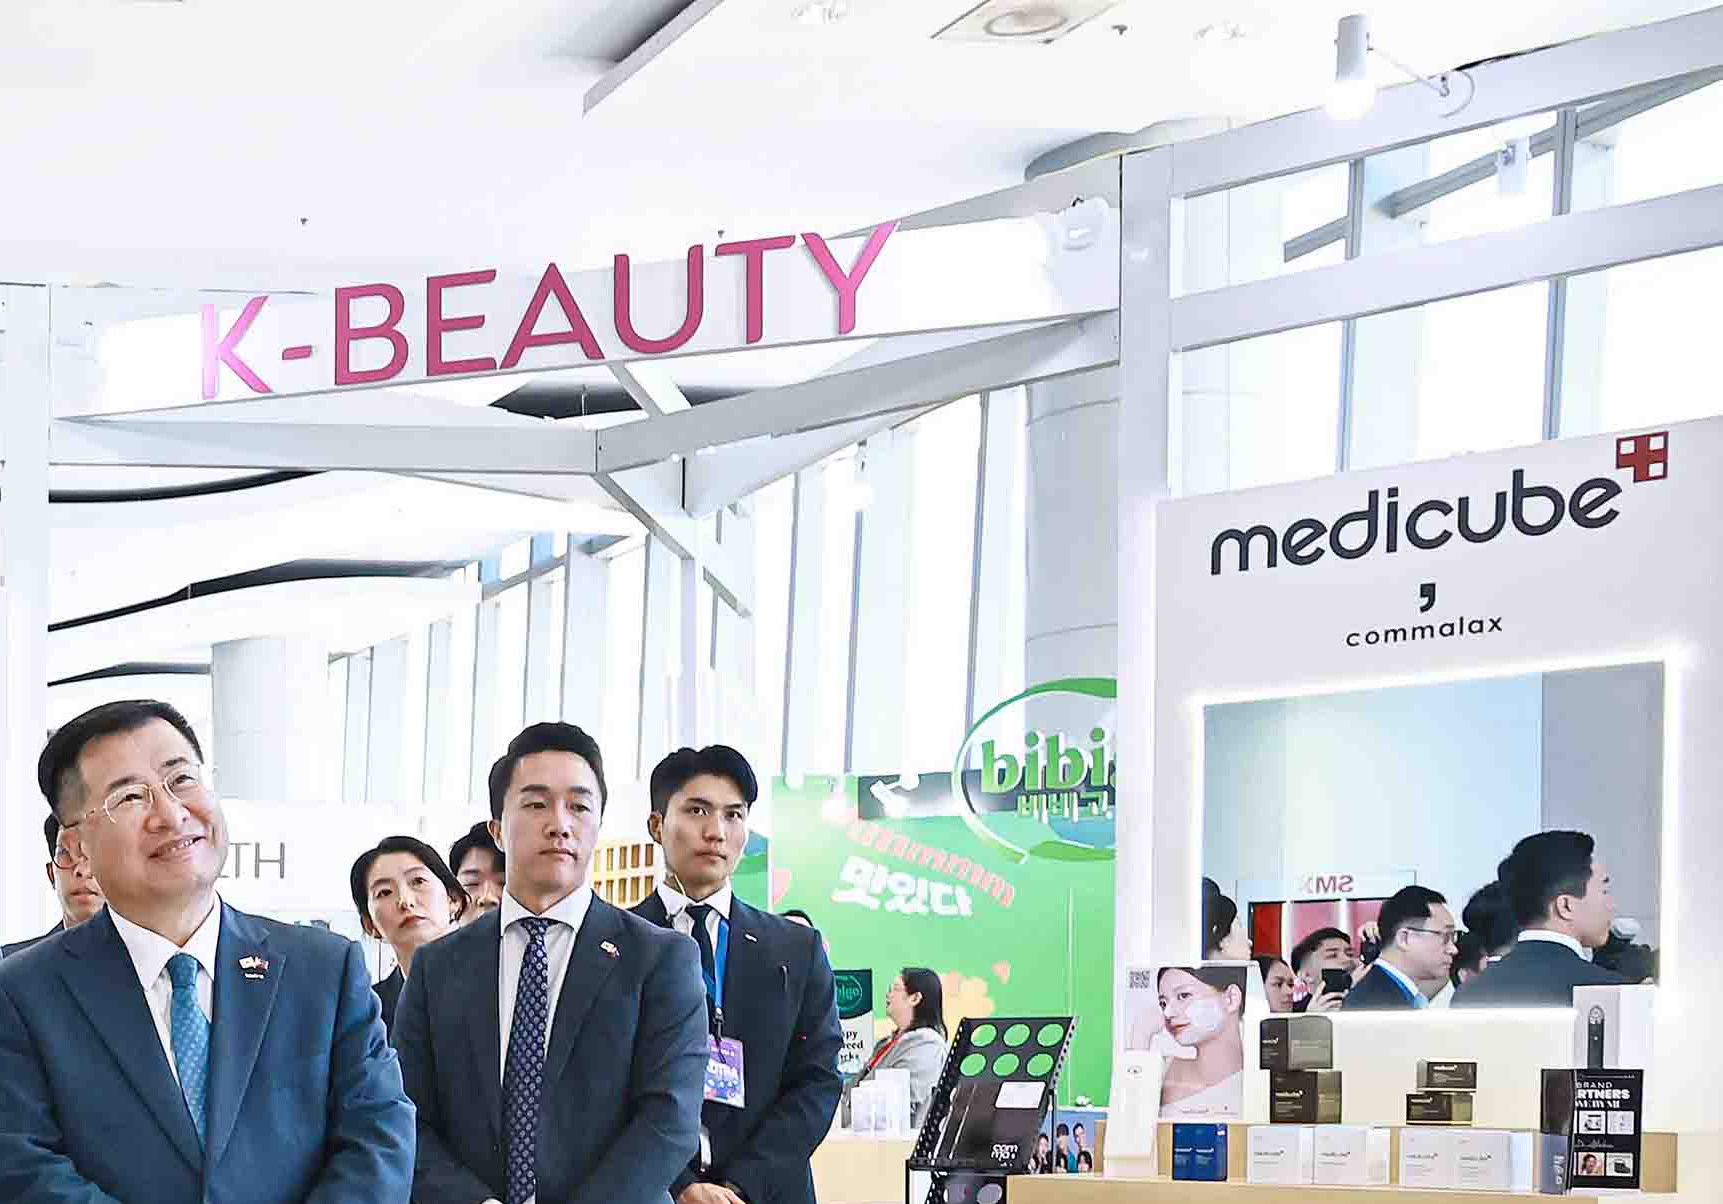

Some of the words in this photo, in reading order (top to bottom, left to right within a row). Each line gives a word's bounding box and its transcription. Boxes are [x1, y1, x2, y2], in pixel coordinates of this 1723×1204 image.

[200, 222, 900, 399] K-BEAUTY
[1210, 468, 1624, 576] medicube
[1345, 615, 1504, 648] commalax
[981, 727, 1116, 795] bibi
[220, 841, 285, 880] TH
[1576, 1089, 1631, 1100] RTNERS
